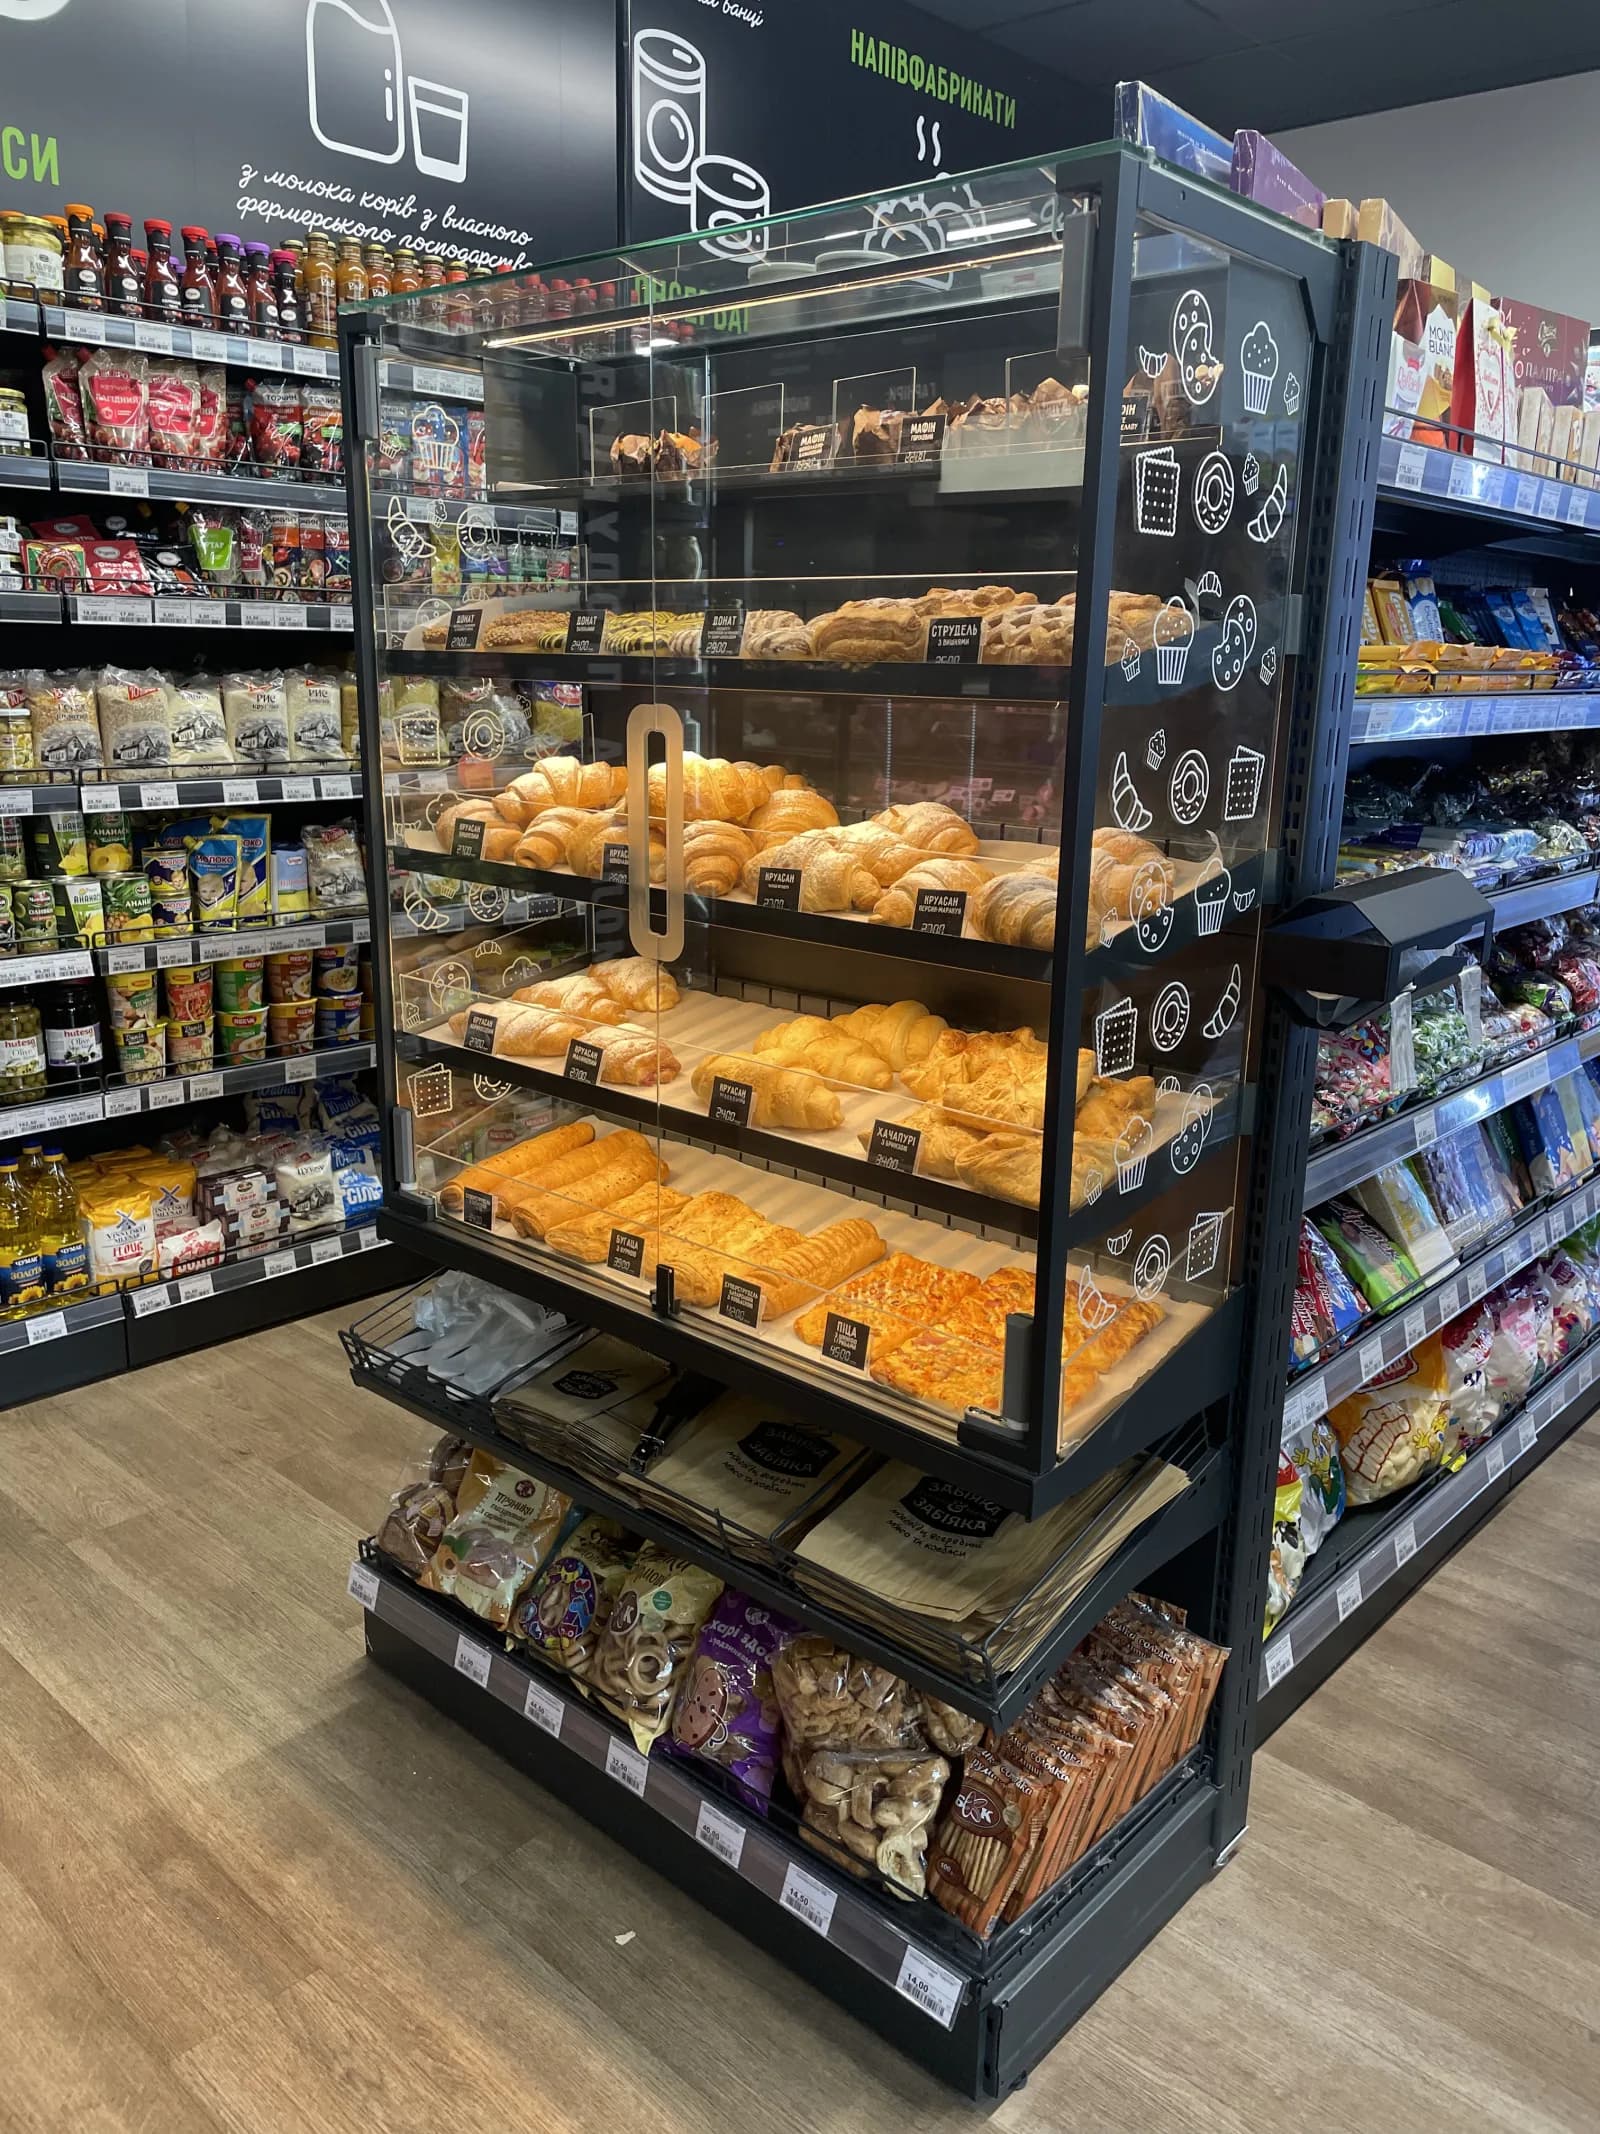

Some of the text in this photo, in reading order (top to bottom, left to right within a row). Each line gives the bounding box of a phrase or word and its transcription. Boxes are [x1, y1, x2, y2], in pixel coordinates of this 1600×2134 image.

[851, 28, 1016, 130] НАПІВФАБРИКАТИ
[241, 163, 533, 248] з молока корів з власного
[237, 196, 397, 243] фермерського
[1429, 326, 1453, 342] MONT
[910, 421, 937, 435] МАФІН
[800, 432, 827, 446] МАФІН
[456, 614, 476, 624] ДОНАТ
[575, 615, 598, 626] ДОНАТ
[712, 615, 738, 626] ДОНАТ
[931, 624, 978, 638] СТРУДЕЛЬ
[195, 854, 235, 866] МОЛОКО
[764, 871, 796, 884] КРУАСАН
[924, 895, 959, 907] КРУАСАН
[574, 1045, 599, 1060] КРУАСАН
[719, 1083, 747, 1096] КРУАСАН
[877, 1127, 917, 1147] ХАЧАПУРІ
[615, 1234, 639, 1250] БУГАЦА
[836, 1320, 857, 1338] ПІЦА
[749, 1441, 813, 1473] ЗАБІЯКА
[913, 1496, 987, 1532] ЗАБІЯКА
[790, 1887, 809, 1906] 14.50
[907, 1973, 929, 1993] 14.00
